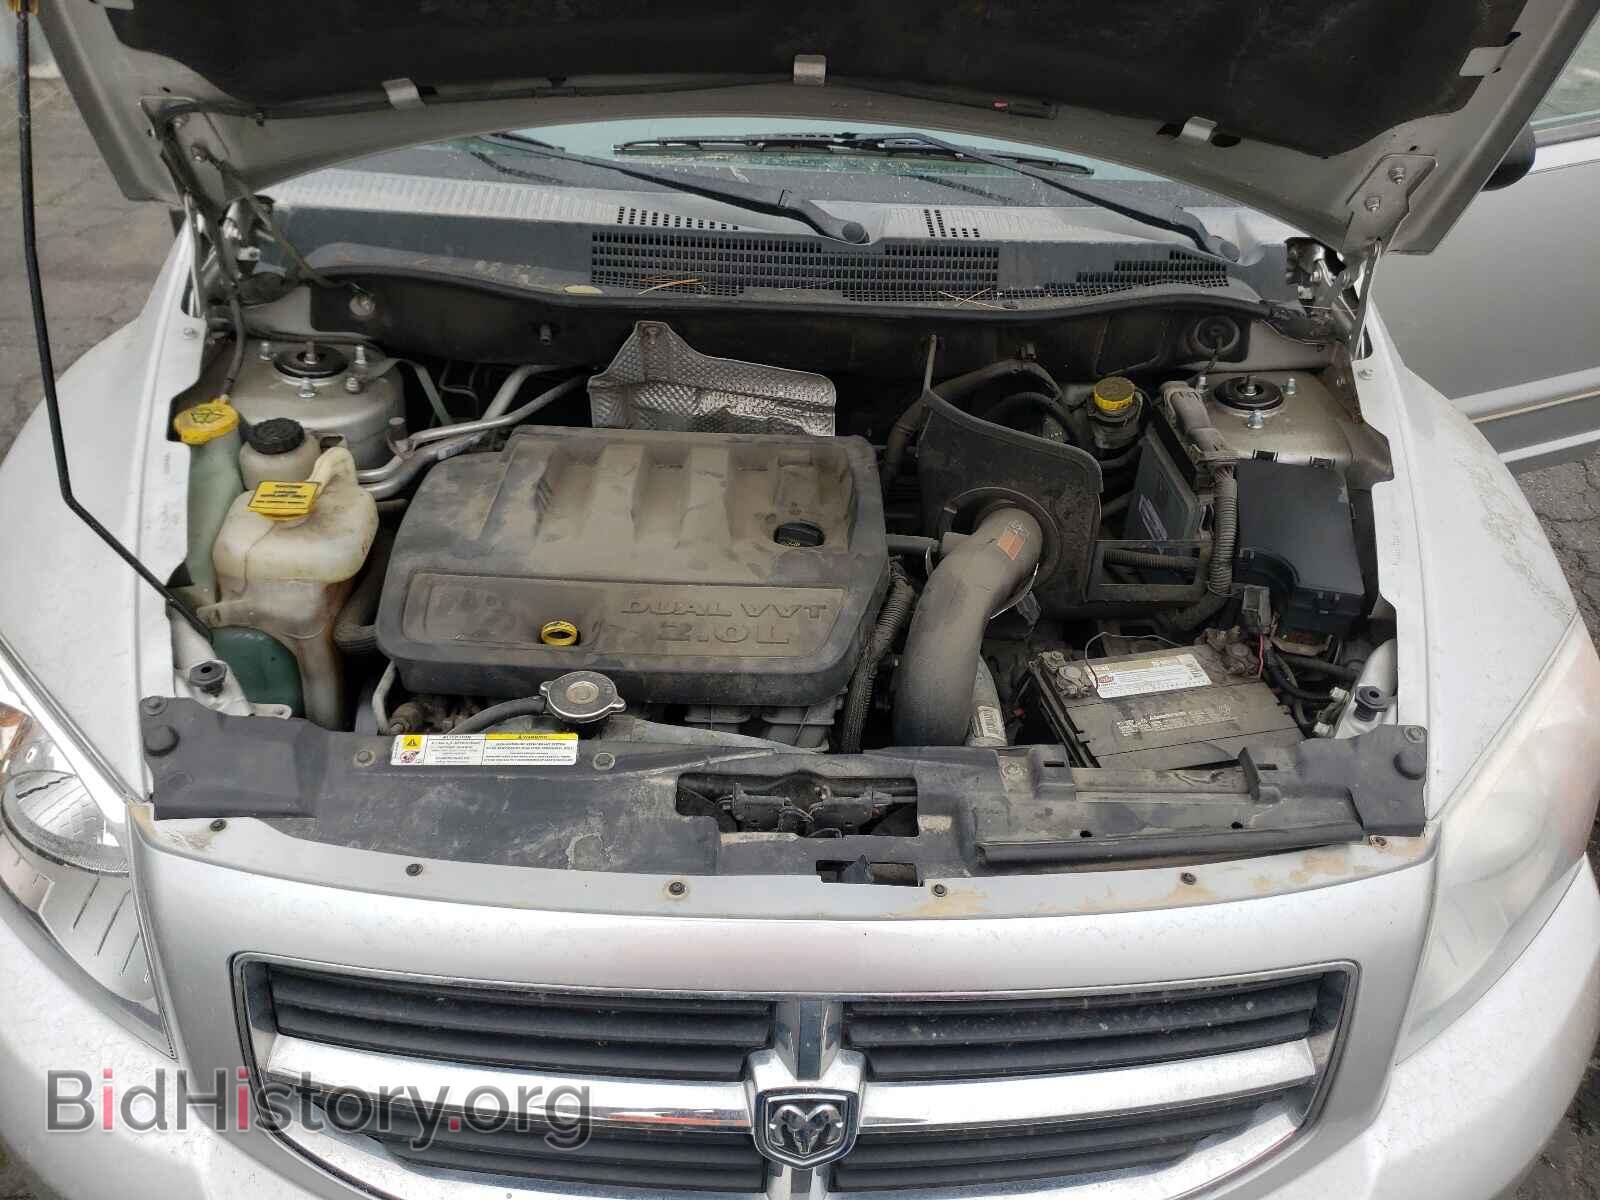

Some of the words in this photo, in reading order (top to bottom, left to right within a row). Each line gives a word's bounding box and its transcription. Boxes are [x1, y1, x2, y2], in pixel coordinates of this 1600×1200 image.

[620, 600, 733, 617] DUAL
[739, 602, 828, 619] VVT
[656, 622, 790, 644] 2.0L
